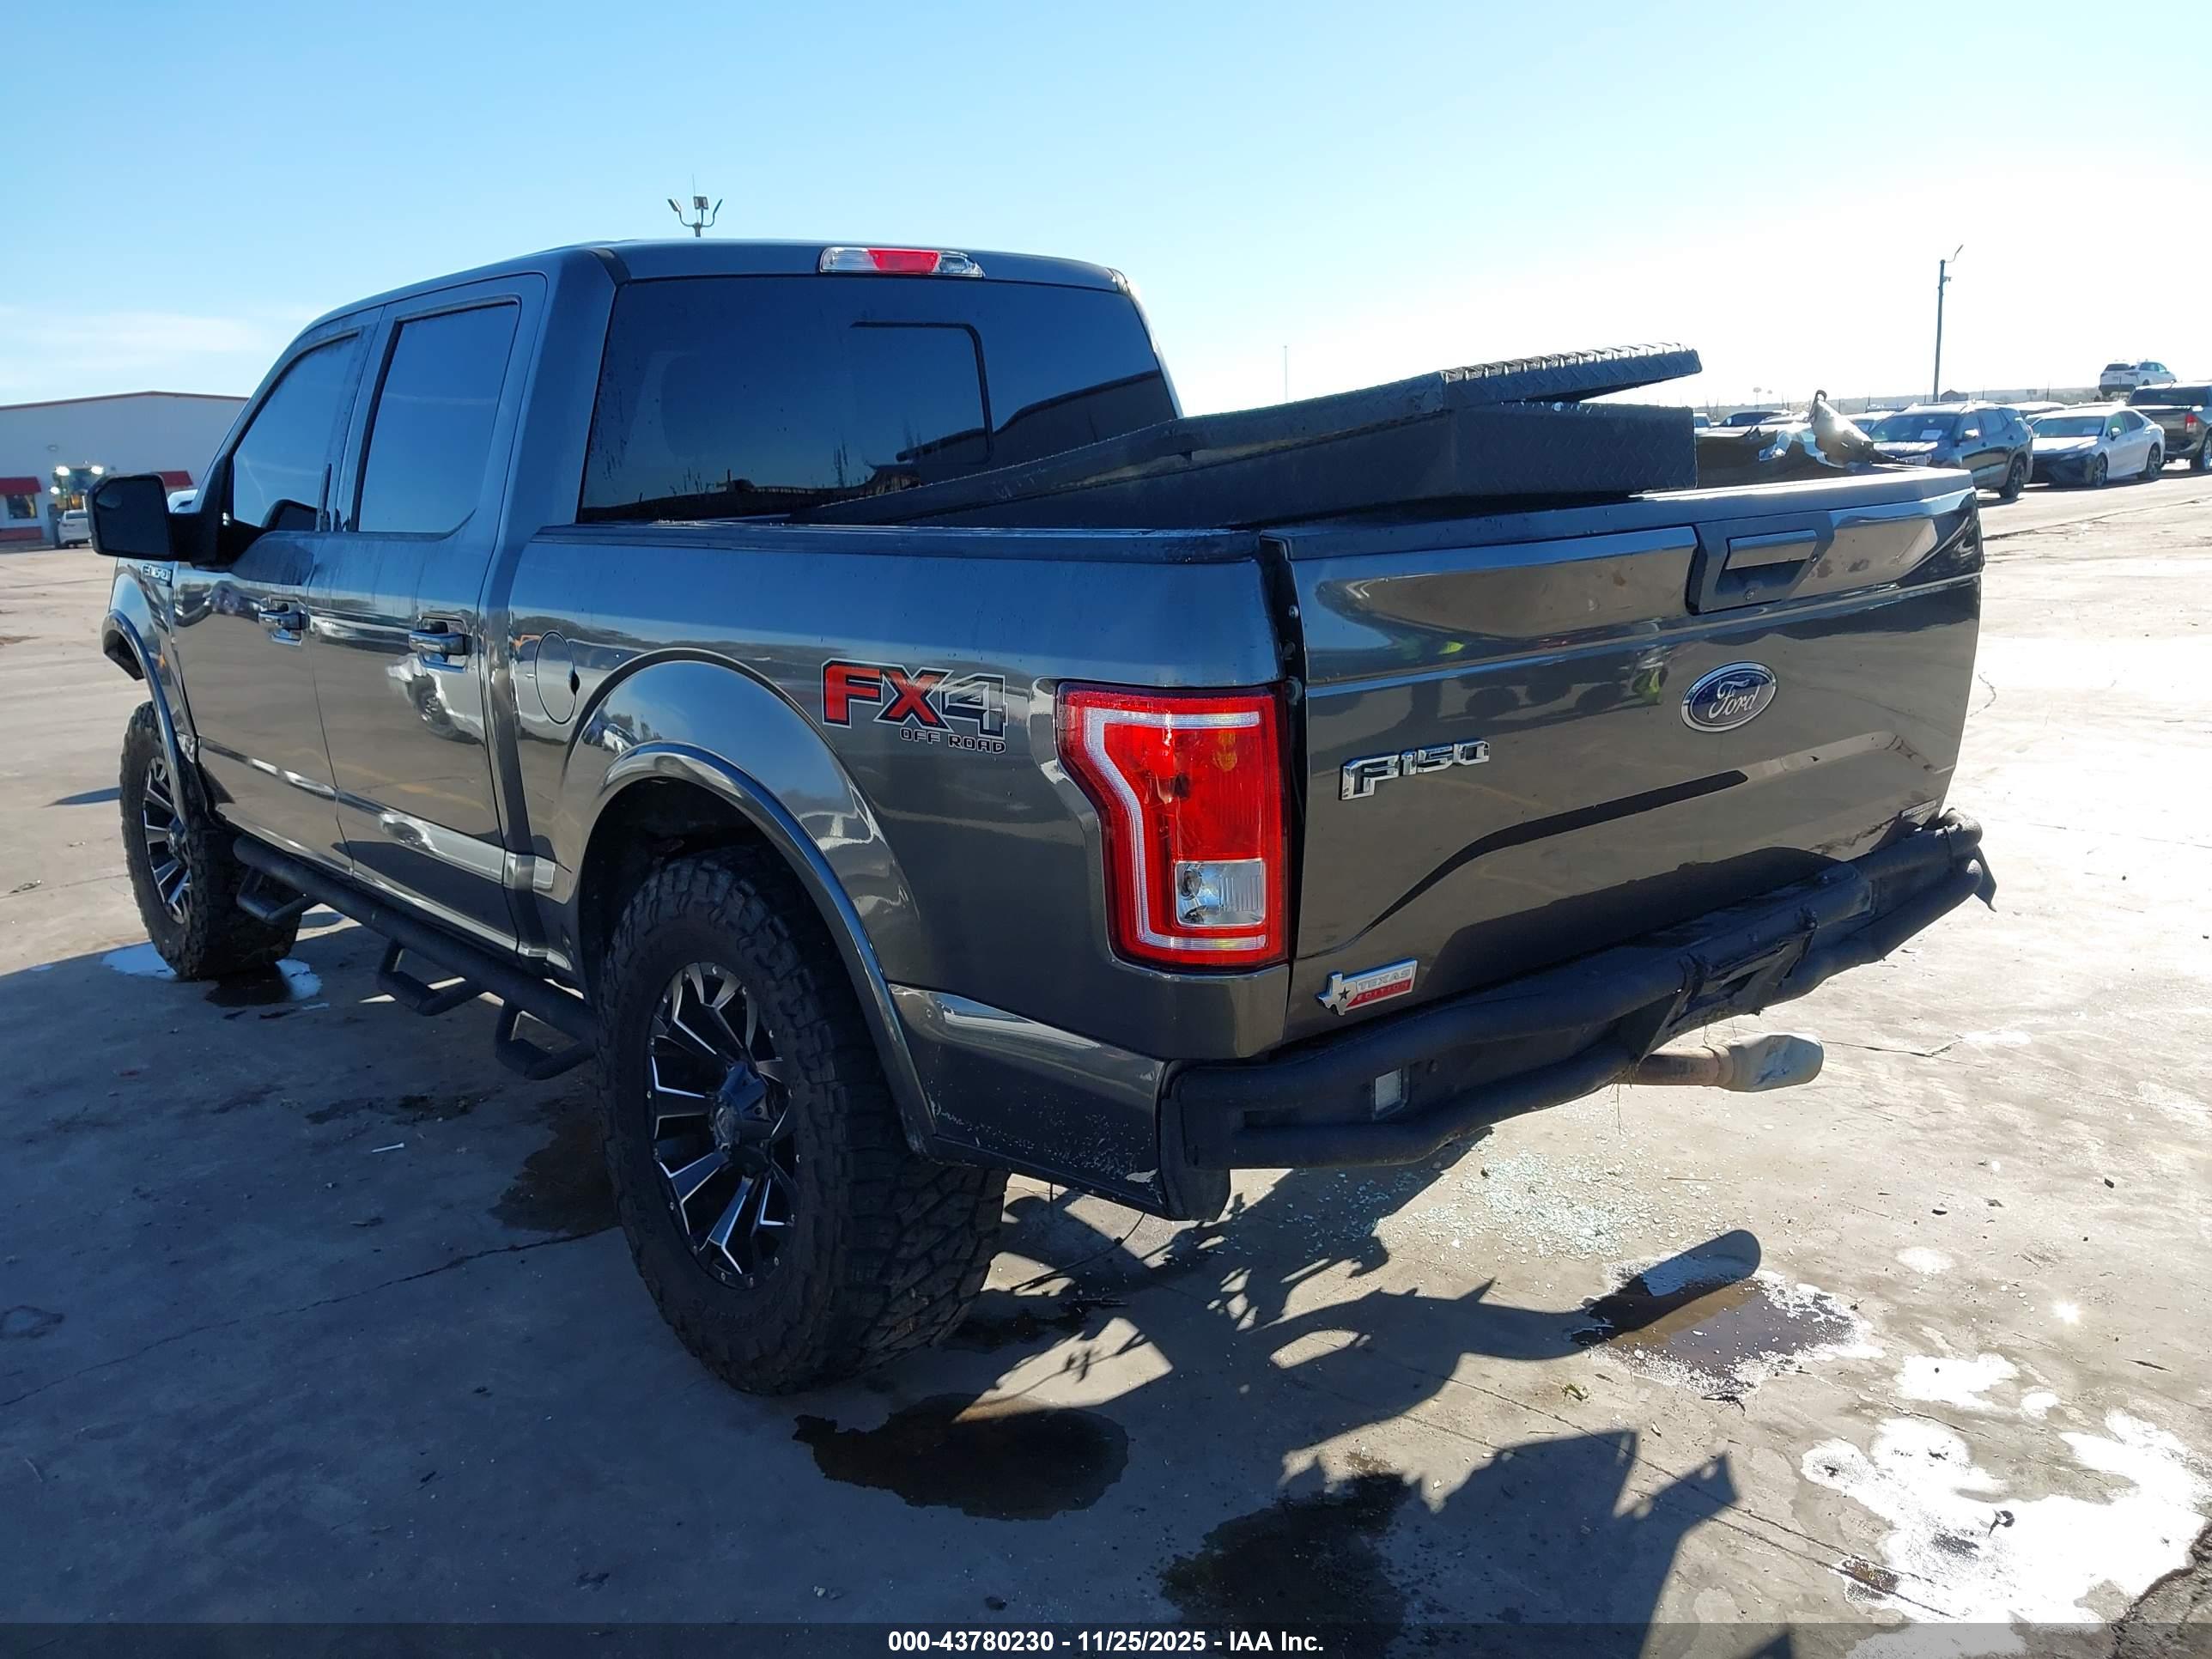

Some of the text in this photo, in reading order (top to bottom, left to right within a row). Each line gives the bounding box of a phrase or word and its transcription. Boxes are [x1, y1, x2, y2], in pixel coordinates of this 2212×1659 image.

[821, 658, 1008, 739] FX4
[1708, 678, 1760, 719] Ford
[900, 727, 1006, 754] OFF ROAD
[1357, 981, 1409, 1001] EDITION
[1358, 968, 1411, 990] TEXAS
